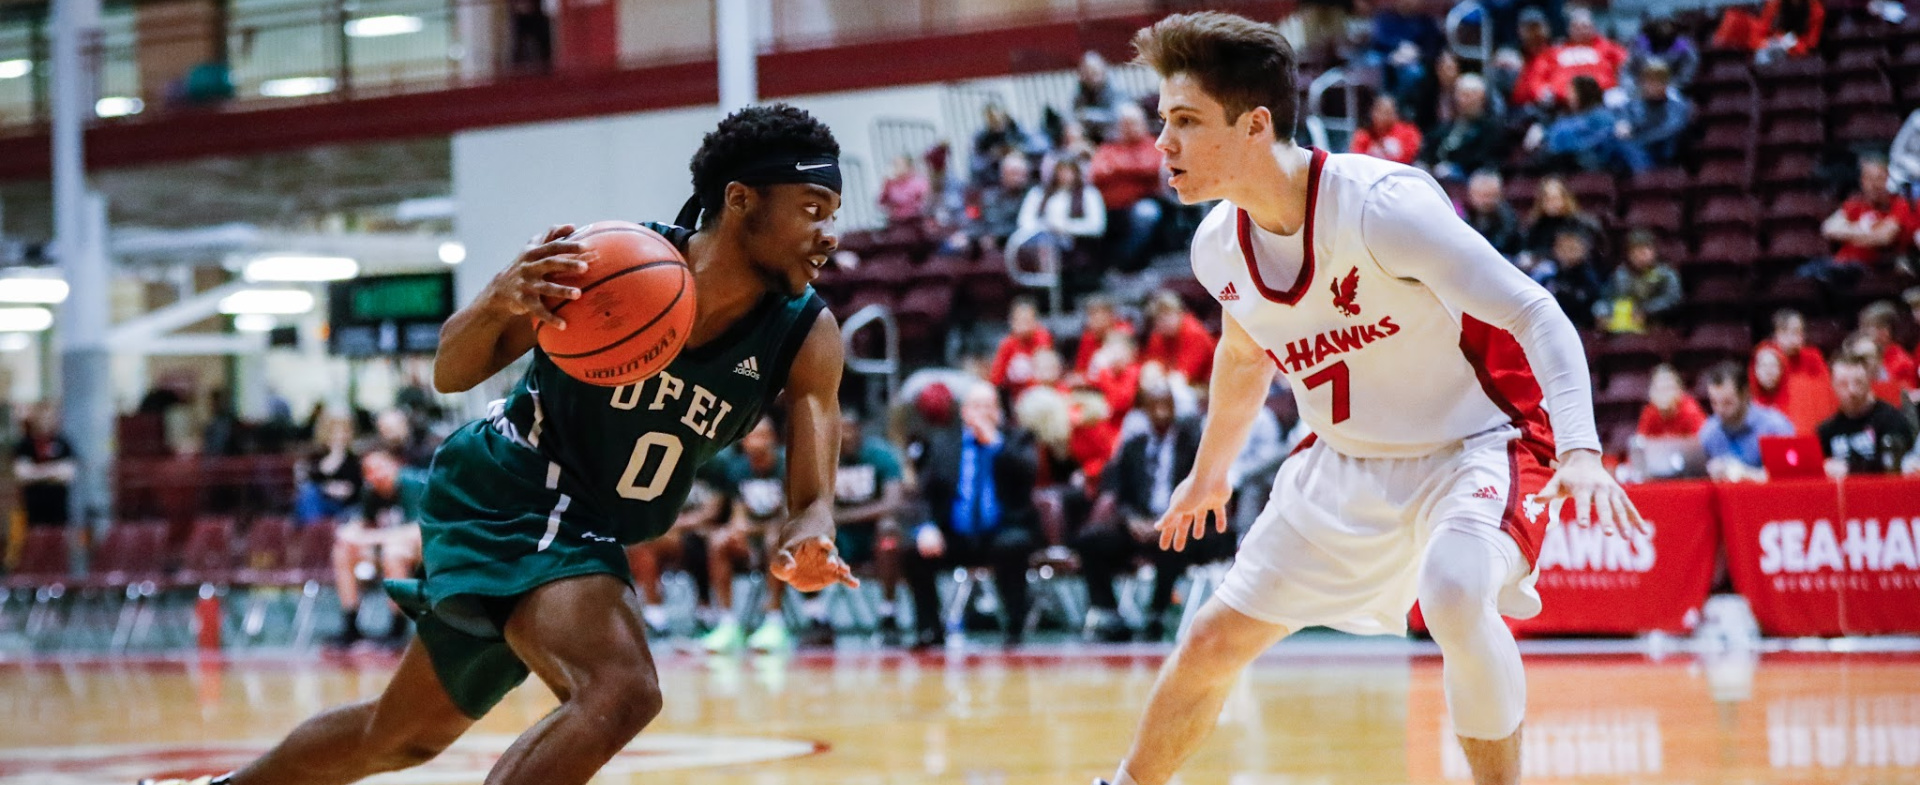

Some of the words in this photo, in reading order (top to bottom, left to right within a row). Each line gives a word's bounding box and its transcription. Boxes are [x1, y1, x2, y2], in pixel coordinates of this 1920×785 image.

[584, 326, 677, 379] EVOLUTION
[609, 370, 733, 440] UPEI
[1302, 360, 1350, 425] 7
[616, 431, 684, 502] 0
[1759, 516, 1920, 575] SEA-HA
